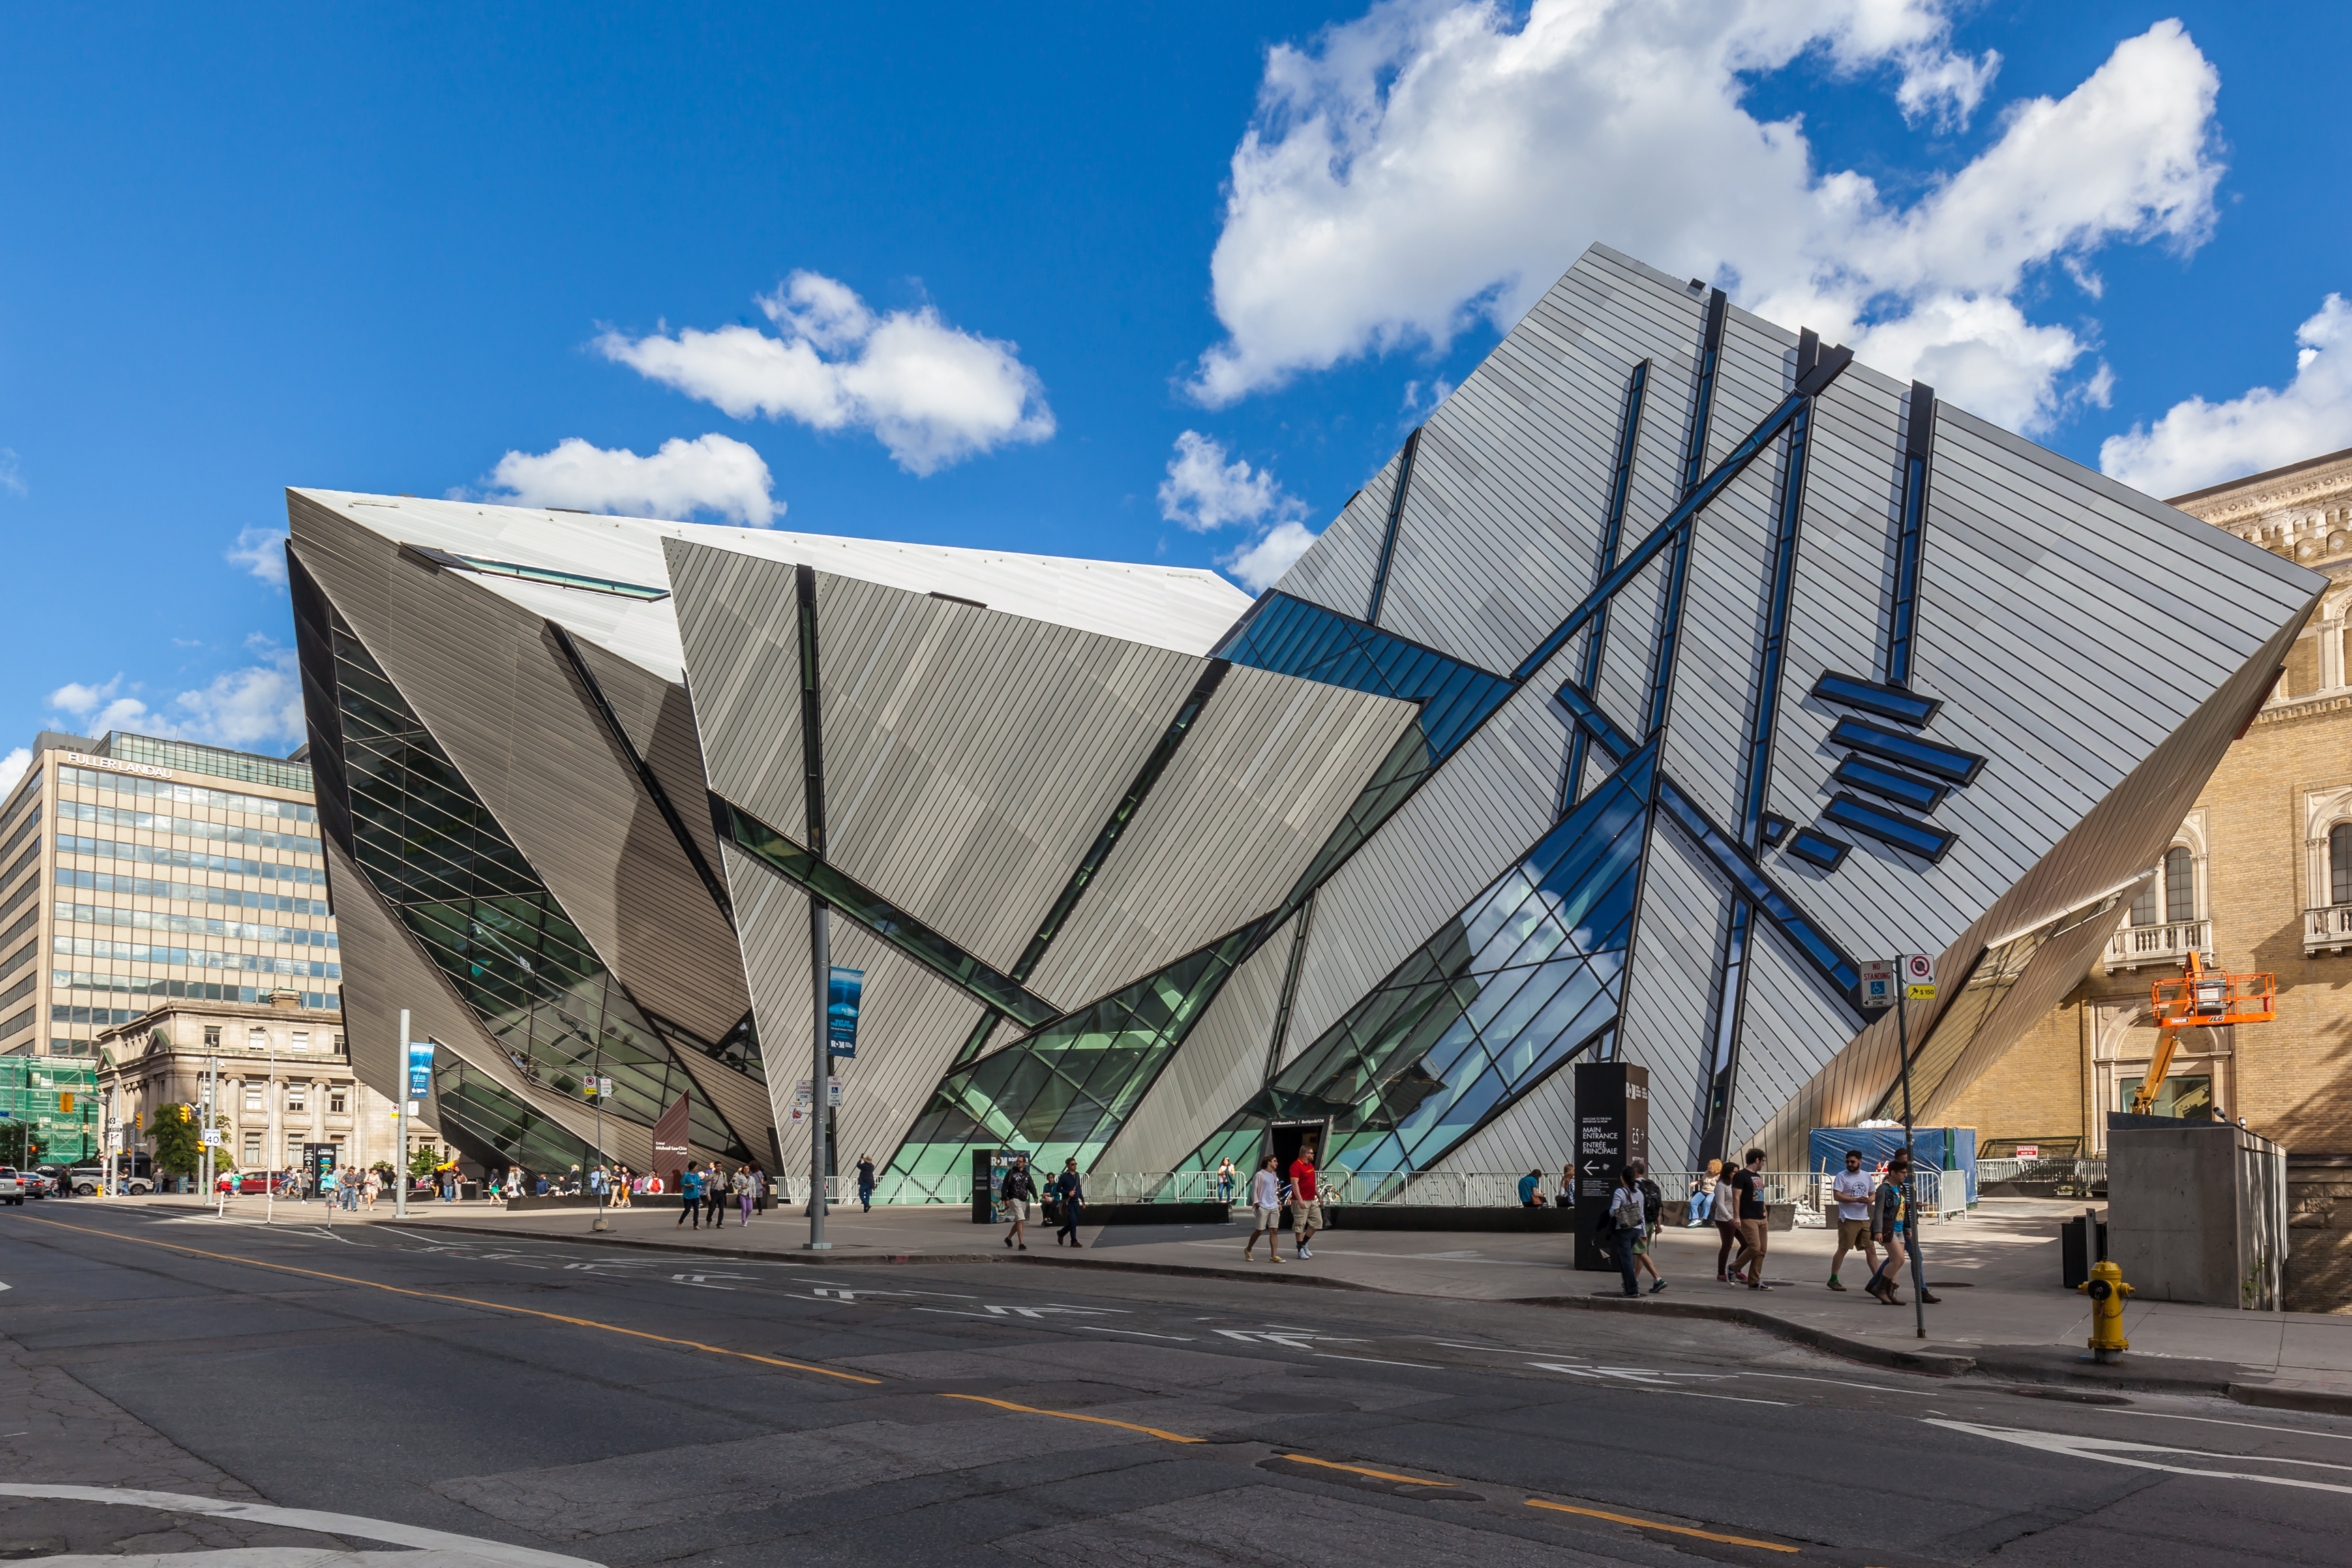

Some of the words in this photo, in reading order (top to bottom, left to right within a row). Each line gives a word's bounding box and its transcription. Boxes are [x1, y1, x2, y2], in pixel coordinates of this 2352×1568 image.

[68, 753, 117, 770] FULLER
[119, 761, 172, 779] LANDAU
[1864, 971, 1891, 981] STANDING
